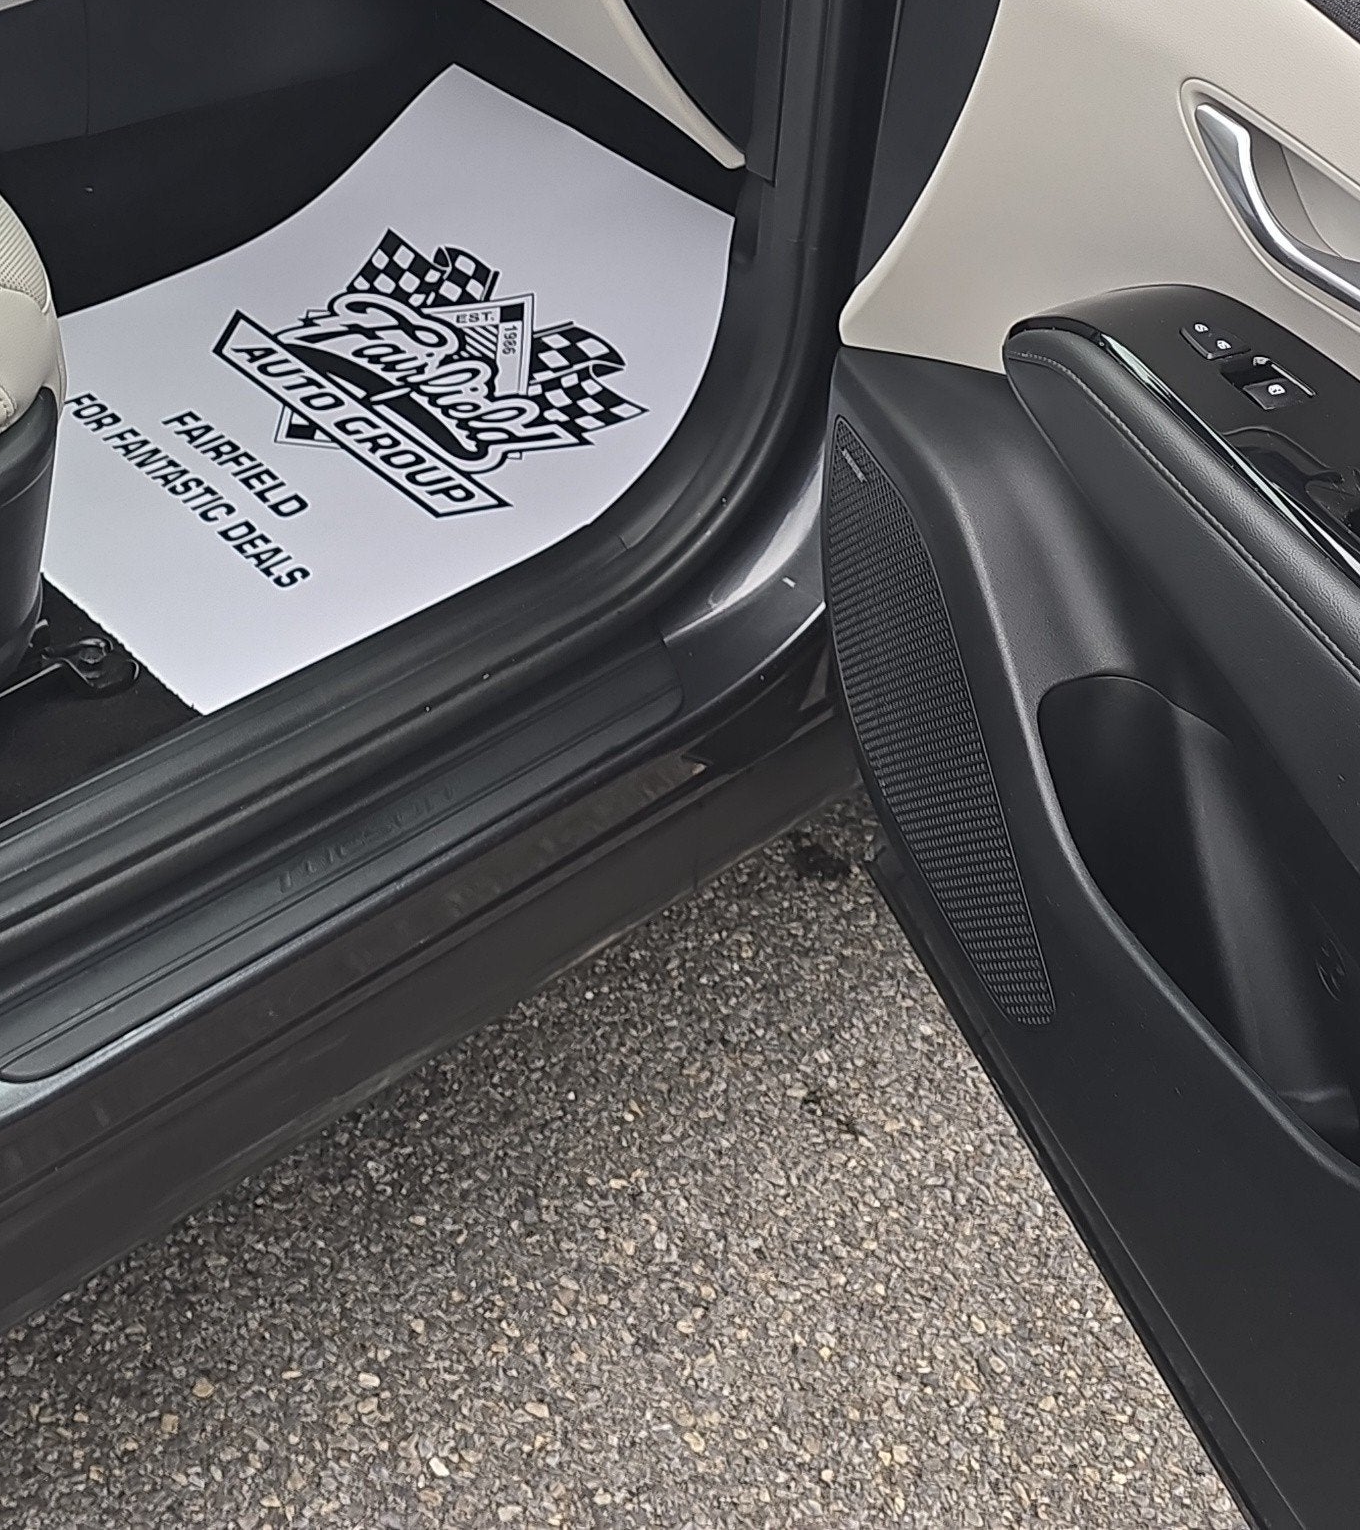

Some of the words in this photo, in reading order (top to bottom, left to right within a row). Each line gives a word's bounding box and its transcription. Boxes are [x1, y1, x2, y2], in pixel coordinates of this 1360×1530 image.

[280, 295, 572, 457] Fairfield
[455, 311, 495, 324] EST.
[64, 392, 122, 433] FOR
[102, 427, 237, 523] FANTASTIC
[217, 519, 311, 588] DEALS
[161, 410, 309, 518] FAIRFIELD
[231, 345, 346, 411] AUTO
[333, 416, 477, 504] GROUP
